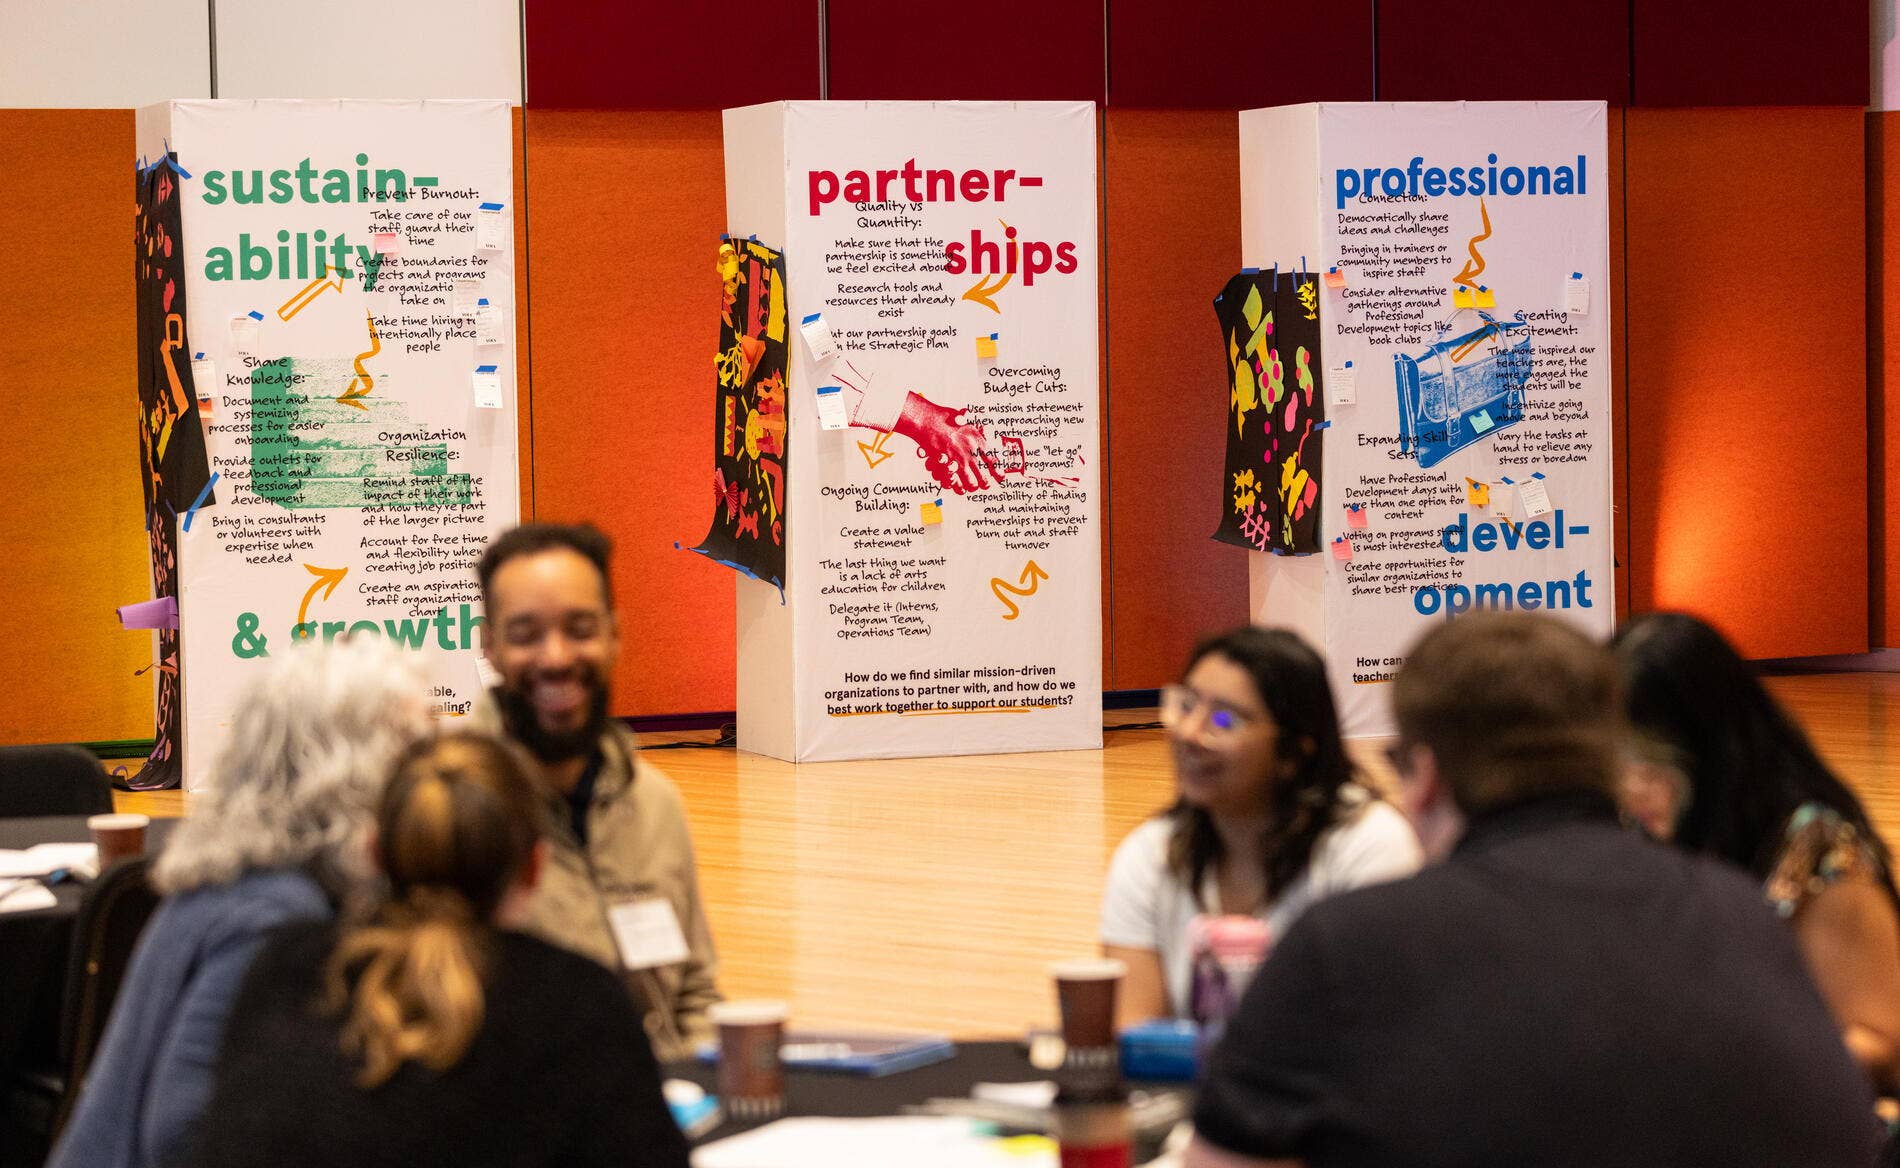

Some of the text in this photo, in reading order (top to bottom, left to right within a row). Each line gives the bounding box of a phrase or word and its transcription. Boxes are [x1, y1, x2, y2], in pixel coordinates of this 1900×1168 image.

[201, 153, 439, 206] sustain-
[1336, 153, 1586, 210] professional
[362, 186, 479, 202] Prevent Burnout:
[809, 158, 1042, 216] partner-
[1359, 191, 1428, 204] Connection:
[855, 200, 923, 214] Quality vs
[370, 209, 401, 220] Take
[437, 209, 449, 219] of
[1338, 211, 1448, 224] Democratically share
[368, 222, 474, 236] staff, guard their
[857, 216, 921, 230] Quantity:
[1338, 223, 1448, 237] ideas and challenges
[409, 236, 434, 245] time
[945, 226, 1078, 286] ships
[1341, 244, 1379, 258] Bringing
[1382, 244, 1391, 253] in
[1394, 243, 1435, 253] trainers
[204, 229, 384, 292] ability
[356, 255, 488, 267] Create boundaries for
[1337, 255, 1451, 268] community members to
[359, 270, 404, 282] projects
[408, 270, 431, 279] and
[435, 271, 485, 284] programs
[1363, 266, 1425, 279] inspire staff
[838, 281, 943, 293] Research tools and
[1342, 286, 1446, 298] Consider alternative
[825, 294, 955, 306] resources that already
[1348, 298, 1441, 312] gatherings around
[878, 307, 904, 317] exist
[1366, 309, 1424, 321] Professional
[1368, 334, 1421, 345] book clubs
[407, 341, 440, 353] people
[243, 357, 288, 368] Share
[227, 370, 305, 389] Knowledge:
[989, 365, 1060, 380] Overcoming
[984, 381, 1067, 397] Budget Cuts:
[223, 395, 283, 408] Document
[285, 395, 310, 407] and
[966, 402, 1083, 413] Use mission statement
[234, 407, 299, 421] systemizing
[208, 420, 325, 435] processes for easier
[967, 415, 994, 428] when
[997, 414, 1060, 429] approaching
[235, 432, 301, 446] onboarding
[378, 429, 467, 443] Organization
[994, 426, 1057, 439] partnerships
[1497, 429, 1588, 443] Vary the tasks at
[1493, 441, 1592, 452] hand to relieve any
[386, 449, 460, 462] Resilience:
[1499, 456, 1528, 465] stress
[1543, 454, 1587, 463] boredom
[1360, 472, 1446, 485] Have Professional
[821, 482, 943, 500] Ongoing Community
[1345, 483, 1462, 498] Development days with
[855, 499, 909, 514] Building:
[212, 513, 325, 529] Bring in consultants
[363, 514, 484, 528] of the larger picture
[1384, 509, 1424, 520] content
[217, 525, 321, 539] or volunteers with
[1442, 510, 1590, 553] devel-
[225, 539, 313, 553] expertise when
[1005, 541, 1050, 549] turnover
[246, 553, 293, 564] needed
[819, 559, 842, 569] The
[845, 558, 867, 569] last
[870, 558, 898, 570] thing
[919, 557, 946, 566] want
[821, 581, 945, 594] education for children
[1414, 569, 1593, 623] opment
[409, 604, 444, 617] chart
[829, 602, 938, 616] Delegate it (Interns,
[845, 615, 924, 629] Program Team,
[231, 612, 270, 659] &
[837, 625, 931, 640] Operations Team)
[845, 665, 1056, 683] How do we find similar mission-driven
[824, 680, 1076, 699] organizations to partner with, and how do we
[827, 695, 1073, 715] best work together to support our students?
